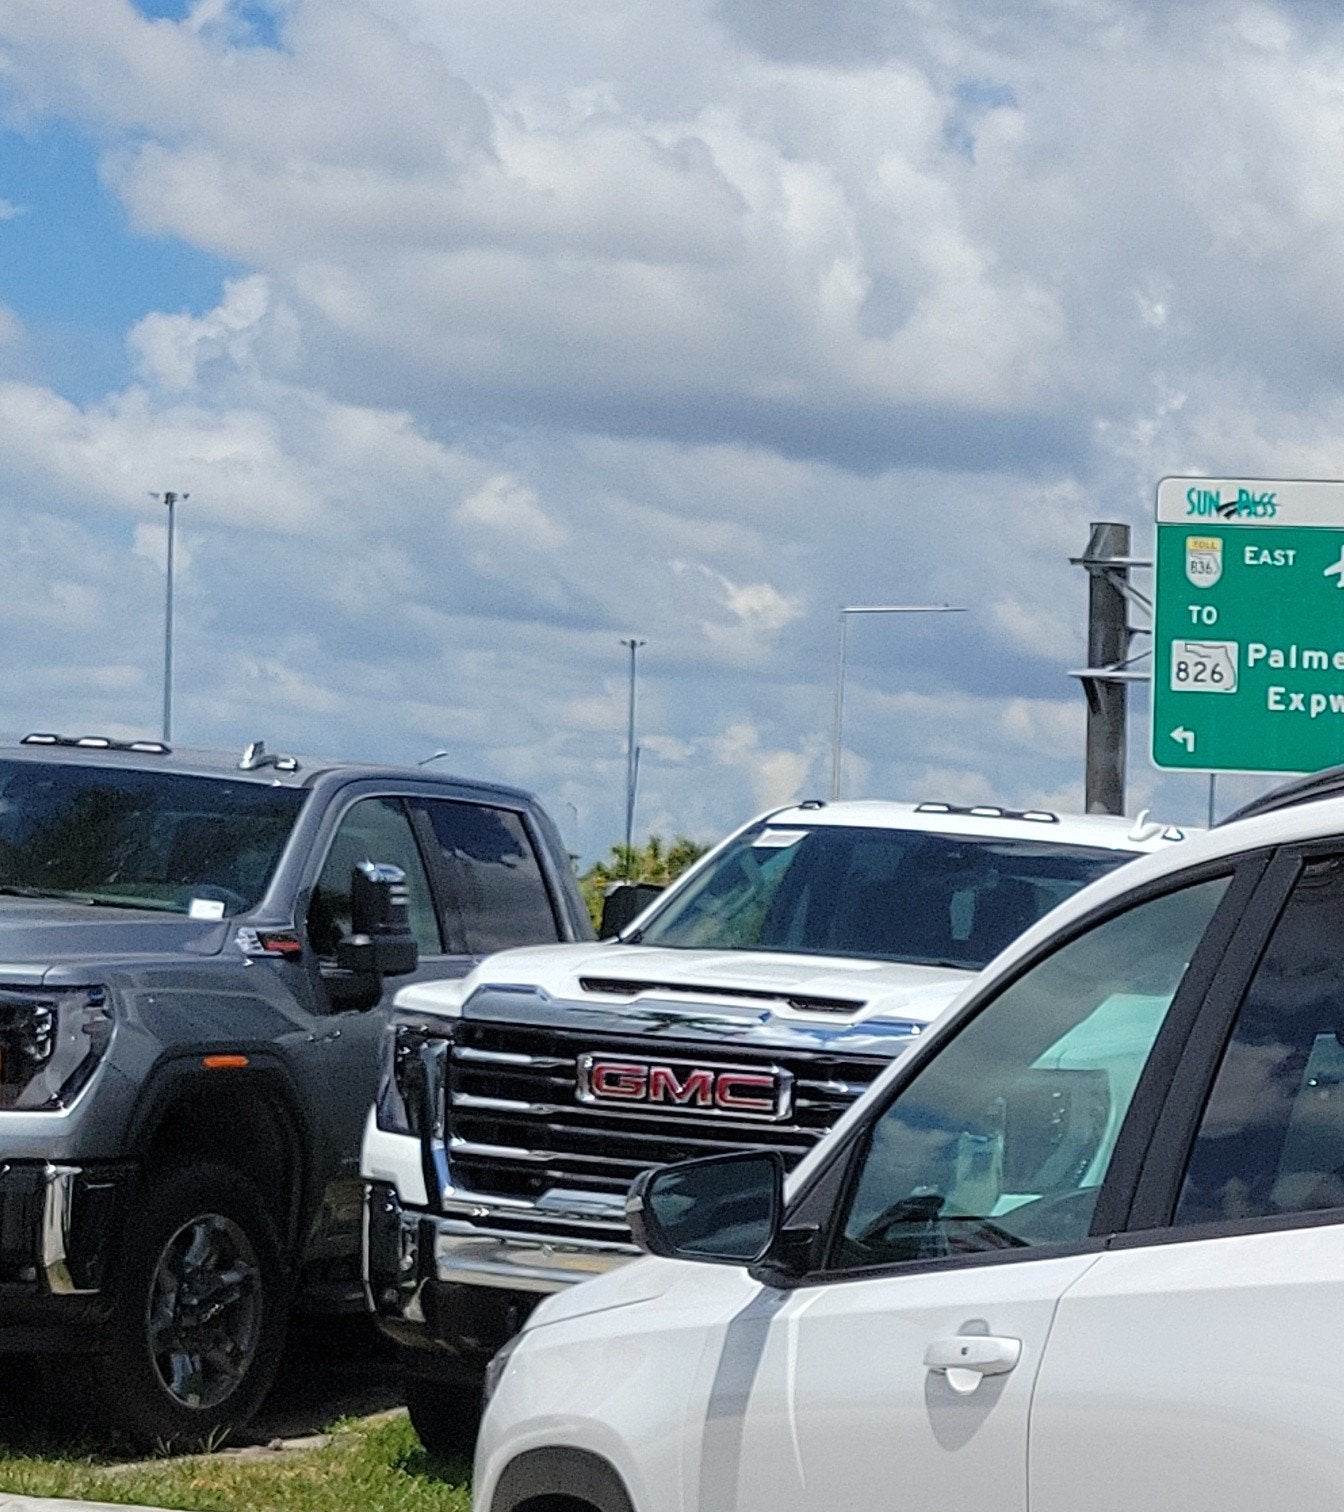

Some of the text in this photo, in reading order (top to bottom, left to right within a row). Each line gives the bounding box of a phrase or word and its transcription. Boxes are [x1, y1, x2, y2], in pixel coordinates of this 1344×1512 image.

[1244, 545, 1296, 566] EAST
[1190, 560, 1213, 575] 836
[1188, 605, 1218, 625] TO
[1176, 661, 1224, 684] 826
[592, 1063, 774, 1111] GMC
